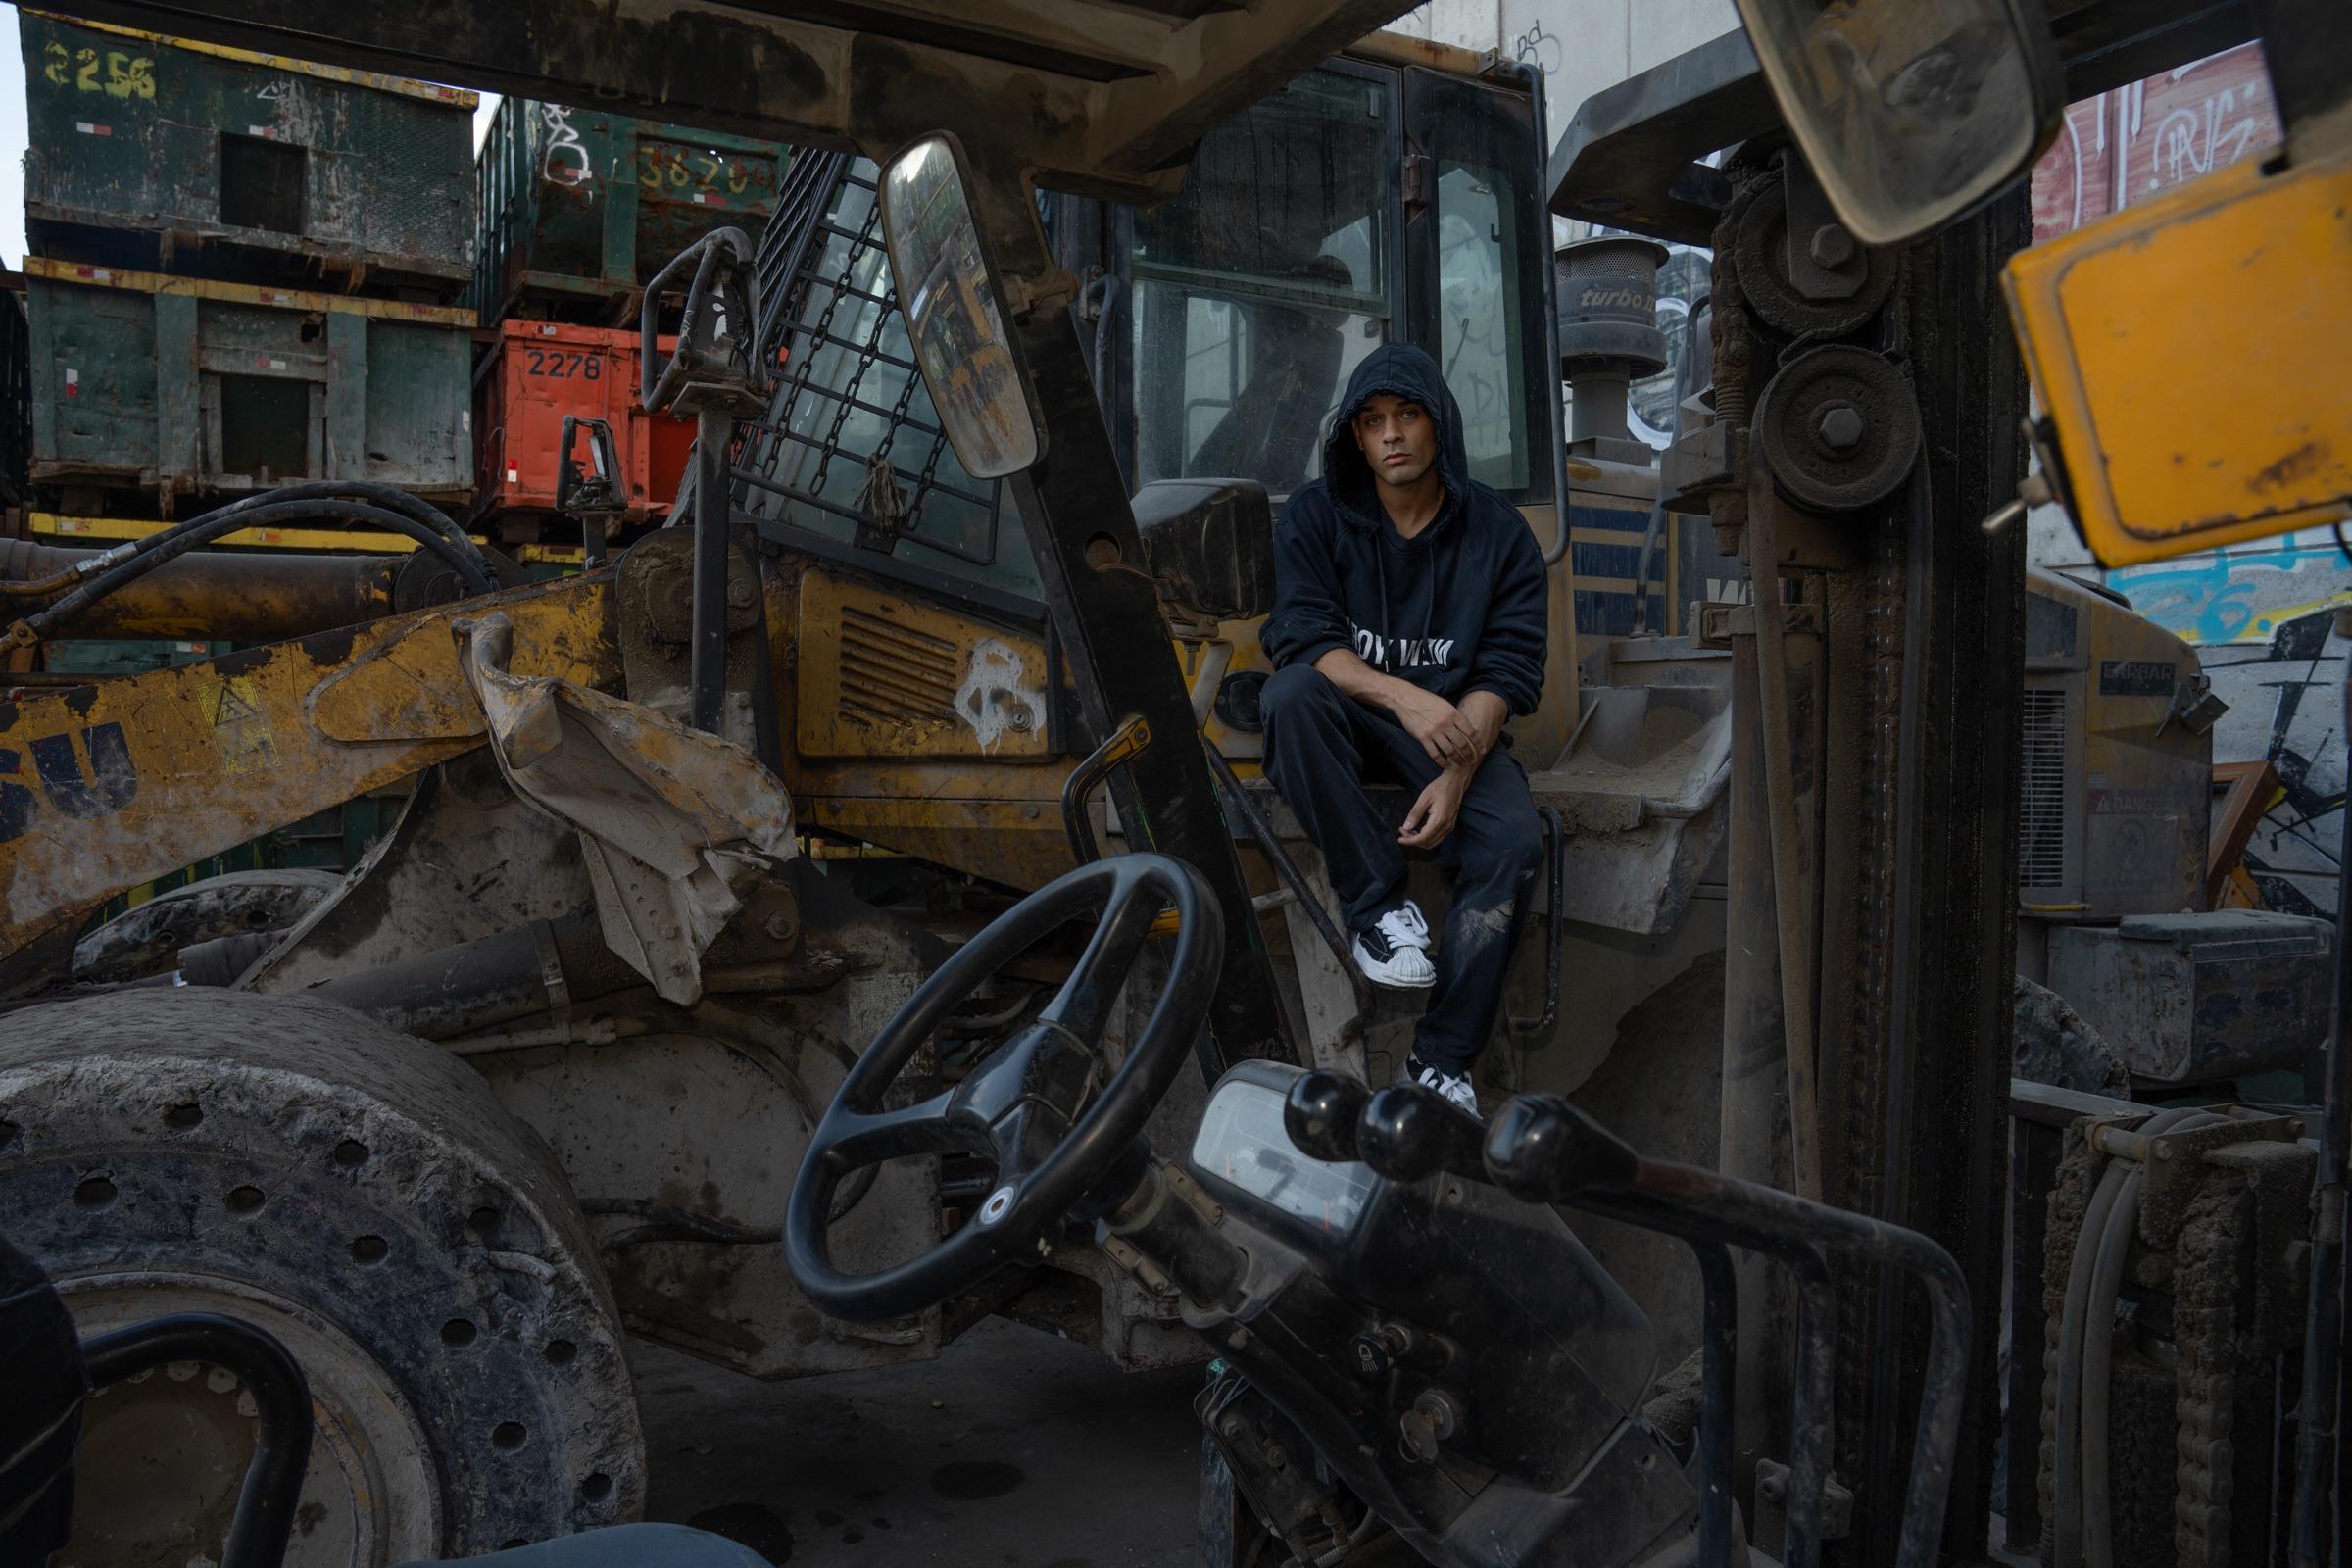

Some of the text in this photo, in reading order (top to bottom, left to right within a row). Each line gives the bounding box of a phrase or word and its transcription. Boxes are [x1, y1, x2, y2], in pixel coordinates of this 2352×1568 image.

[1580, 288, 1642, 309] turbo
[528, 350, 600, 380] 2278
[2113, 795, 2166, 813] DANG
